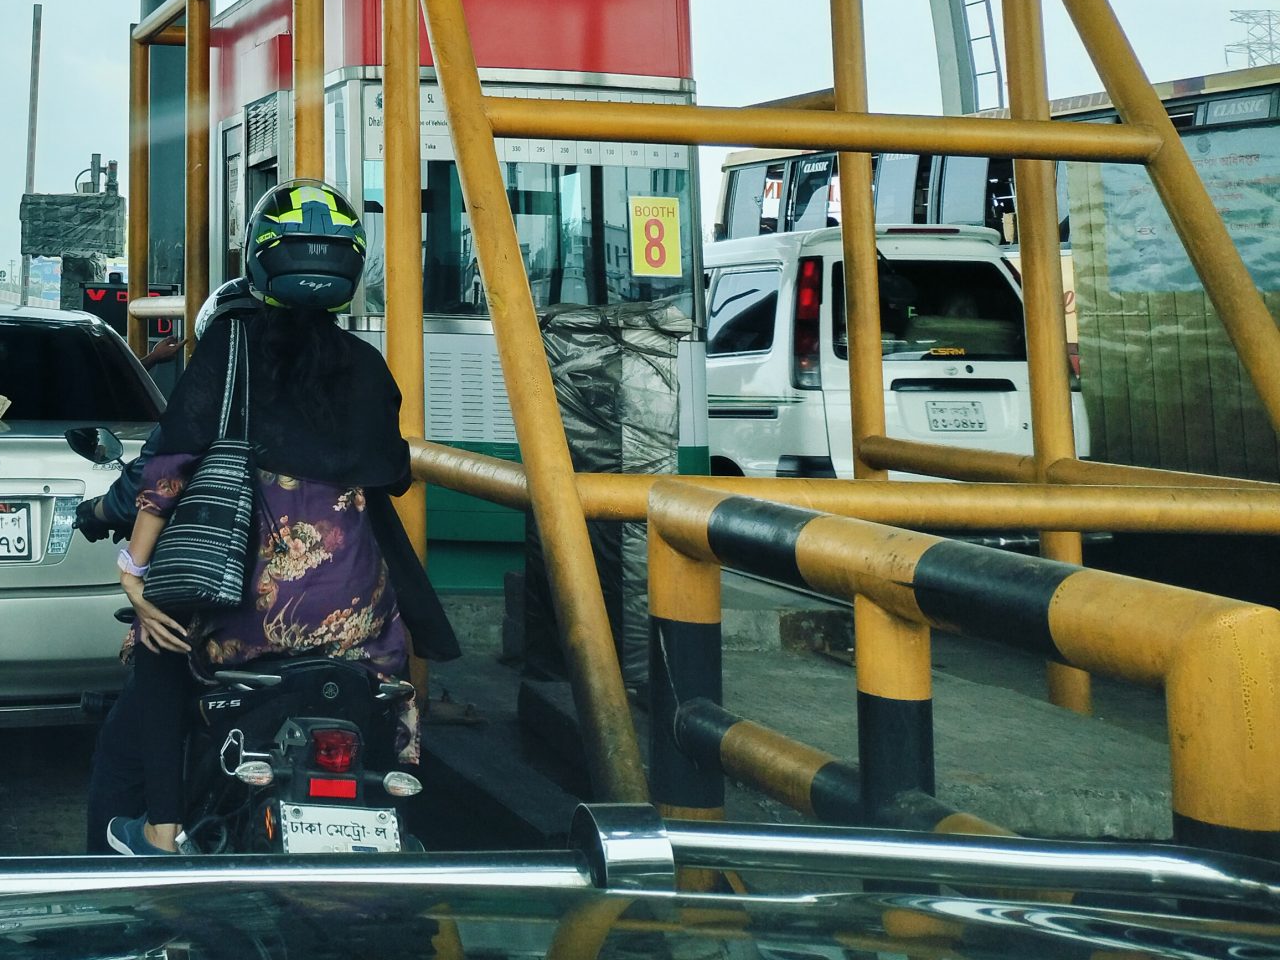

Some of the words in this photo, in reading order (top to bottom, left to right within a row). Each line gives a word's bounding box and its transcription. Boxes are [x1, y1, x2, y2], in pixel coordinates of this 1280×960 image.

[427, 93, 435, 104] SL
[1213, 98, 1265, 118] CLASSIC
[634, 205, 676, 218] BOOTH
[644, 218, 667, 268] 8
[930, 347, 965, 356] CSRM
[207, 698, 241, 710] FZ-S
[289, 821, 322, 835] ঢাকা
